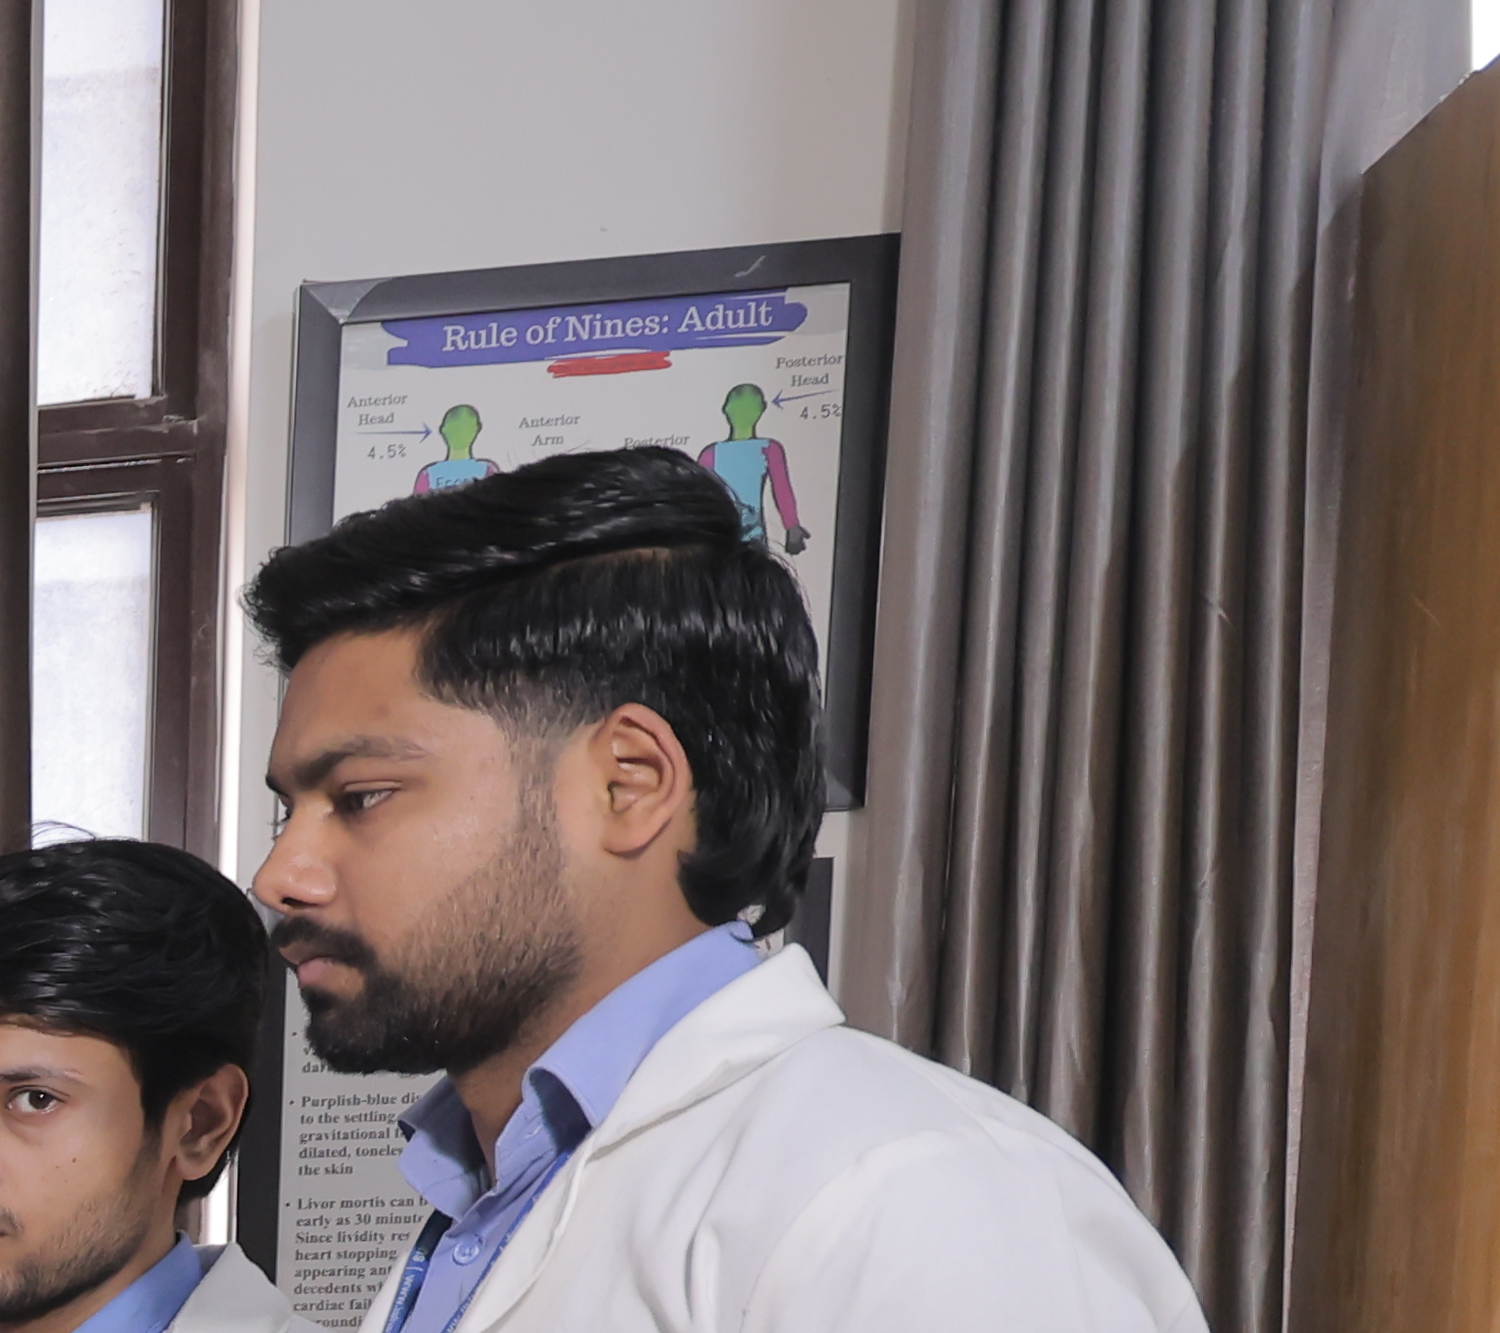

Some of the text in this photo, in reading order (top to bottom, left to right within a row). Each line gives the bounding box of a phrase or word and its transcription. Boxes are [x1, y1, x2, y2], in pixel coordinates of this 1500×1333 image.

[441, 303, 773, 352] Rule of Nines: Adult
[775, 352, 843, 371] Posterior
[790, 373, 830, 387] Head
[348, 393, 408, 409] Anterior
[357, 411, 395, 427] Head
[799, 403, 843, 421] 4.5%
[518, 413, 581, 429] Anterior
[530, 434, 565, 447] Arm
[366, 444, 406, 461] 4.5%
[300, 1093, 398, 1110] Purplish-blue
[299, 1127, 390, 1145] gravitational
[298, 1147, 352, 1160] dilated,
[297, 1162, 354, 1176] the skin
[297, 1196, 415, 1210] Livor mortis can
